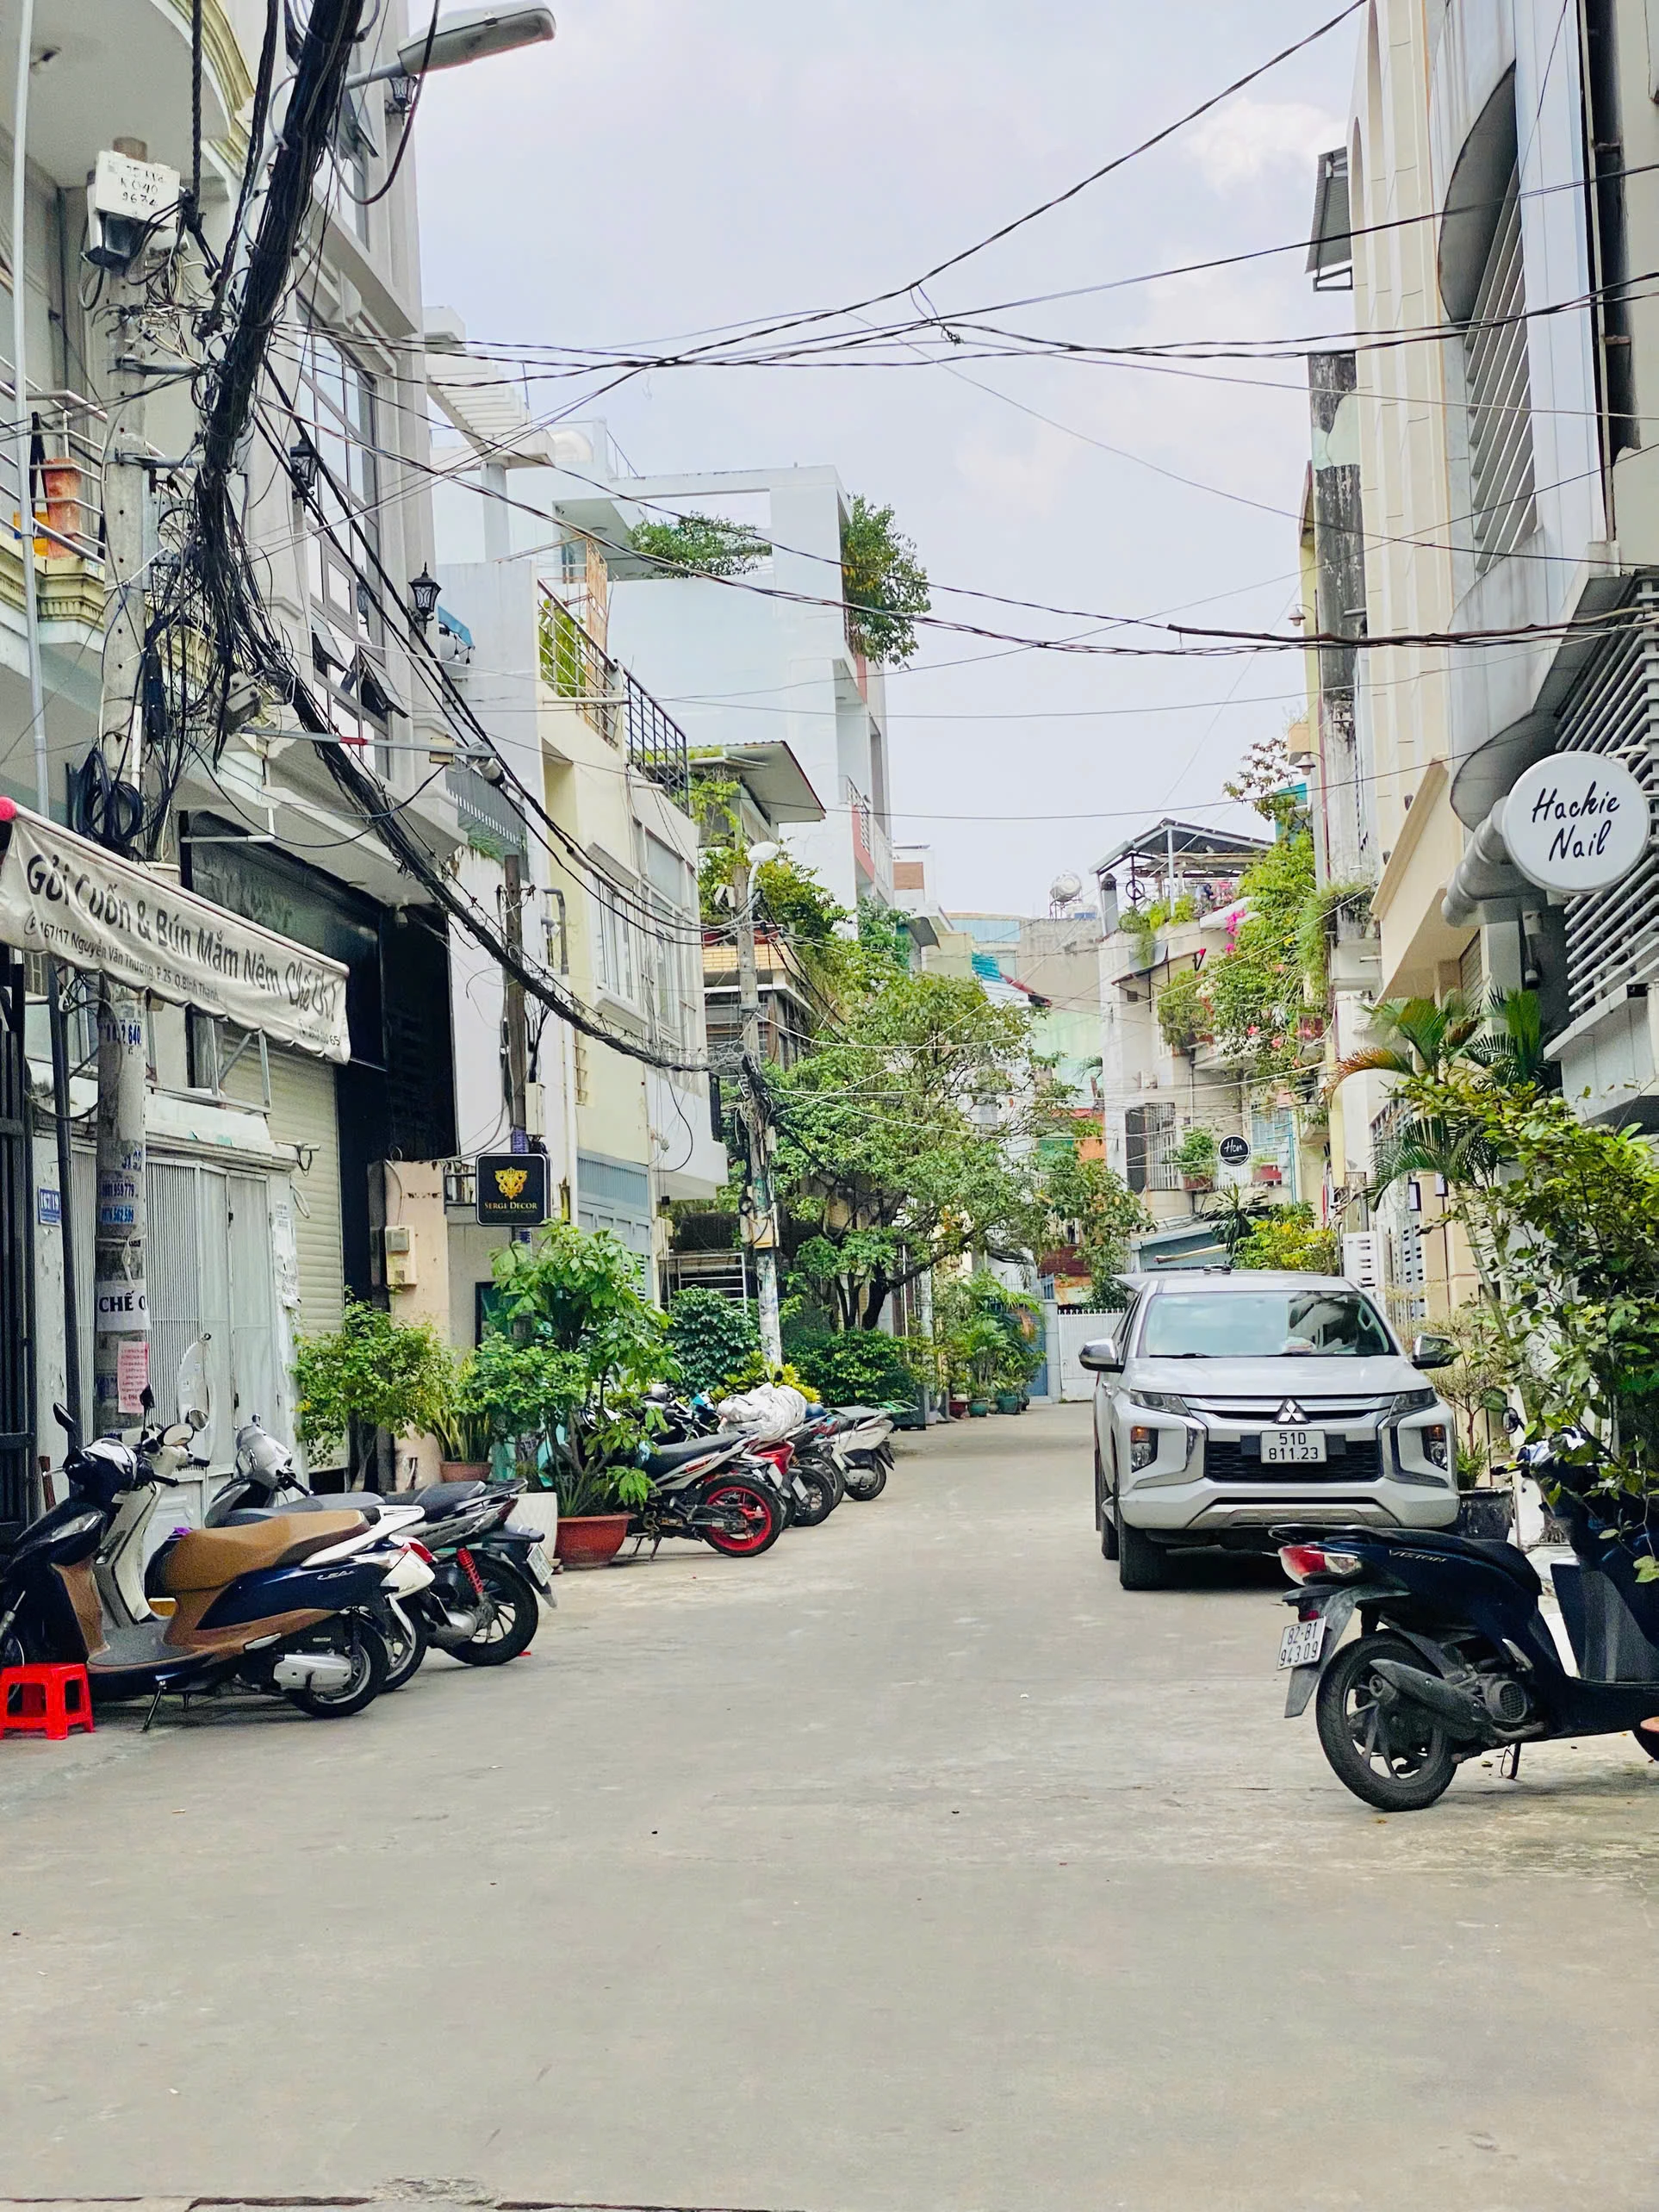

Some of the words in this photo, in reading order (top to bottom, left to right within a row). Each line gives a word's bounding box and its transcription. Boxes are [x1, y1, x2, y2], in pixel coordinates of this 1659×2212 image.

[1532, 780, 1620, 823] Hackie
[1549, 819, 1612, 862] Nail
[137, 899, 152, 941] &
[244, 948, 283, 997] Nêm
[99, 1290, 134, 1313] CHẾ
[1269, 1447, 1319, 1461] 811.23
[1279, 1432, 1307, 1446] 51D
